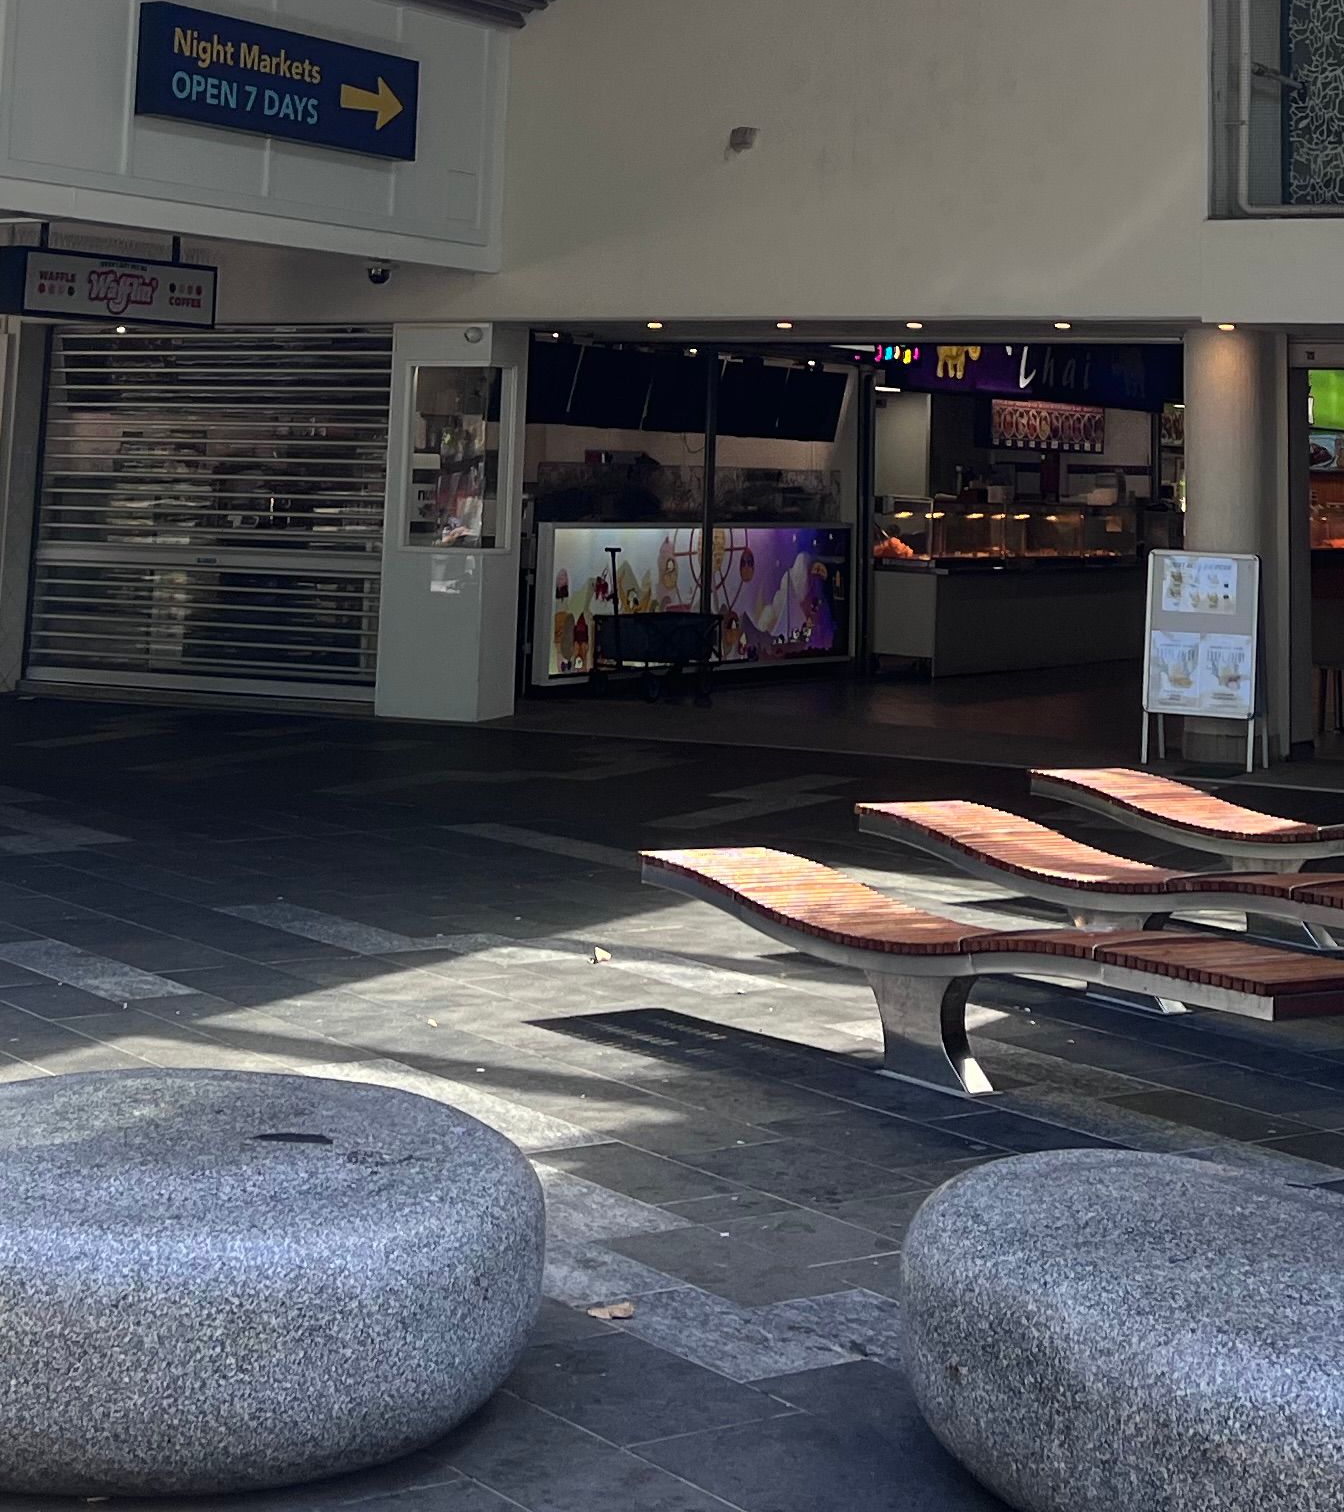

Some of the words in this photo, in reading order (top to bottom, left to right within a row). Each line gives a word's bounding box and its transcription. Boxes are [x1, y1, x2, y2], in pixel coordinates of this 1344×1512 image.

[173, 27, 234, 69] Night
[240, 42, 321, 84] Markets
[172, 71, 237, 109] OPEN
[244, 86, 257, 111] 7
[264, 89, 319, 125] DAYS
[39, 271, 76, 283] WAFFLE
[169, 297, 202, 308] COFFEE
